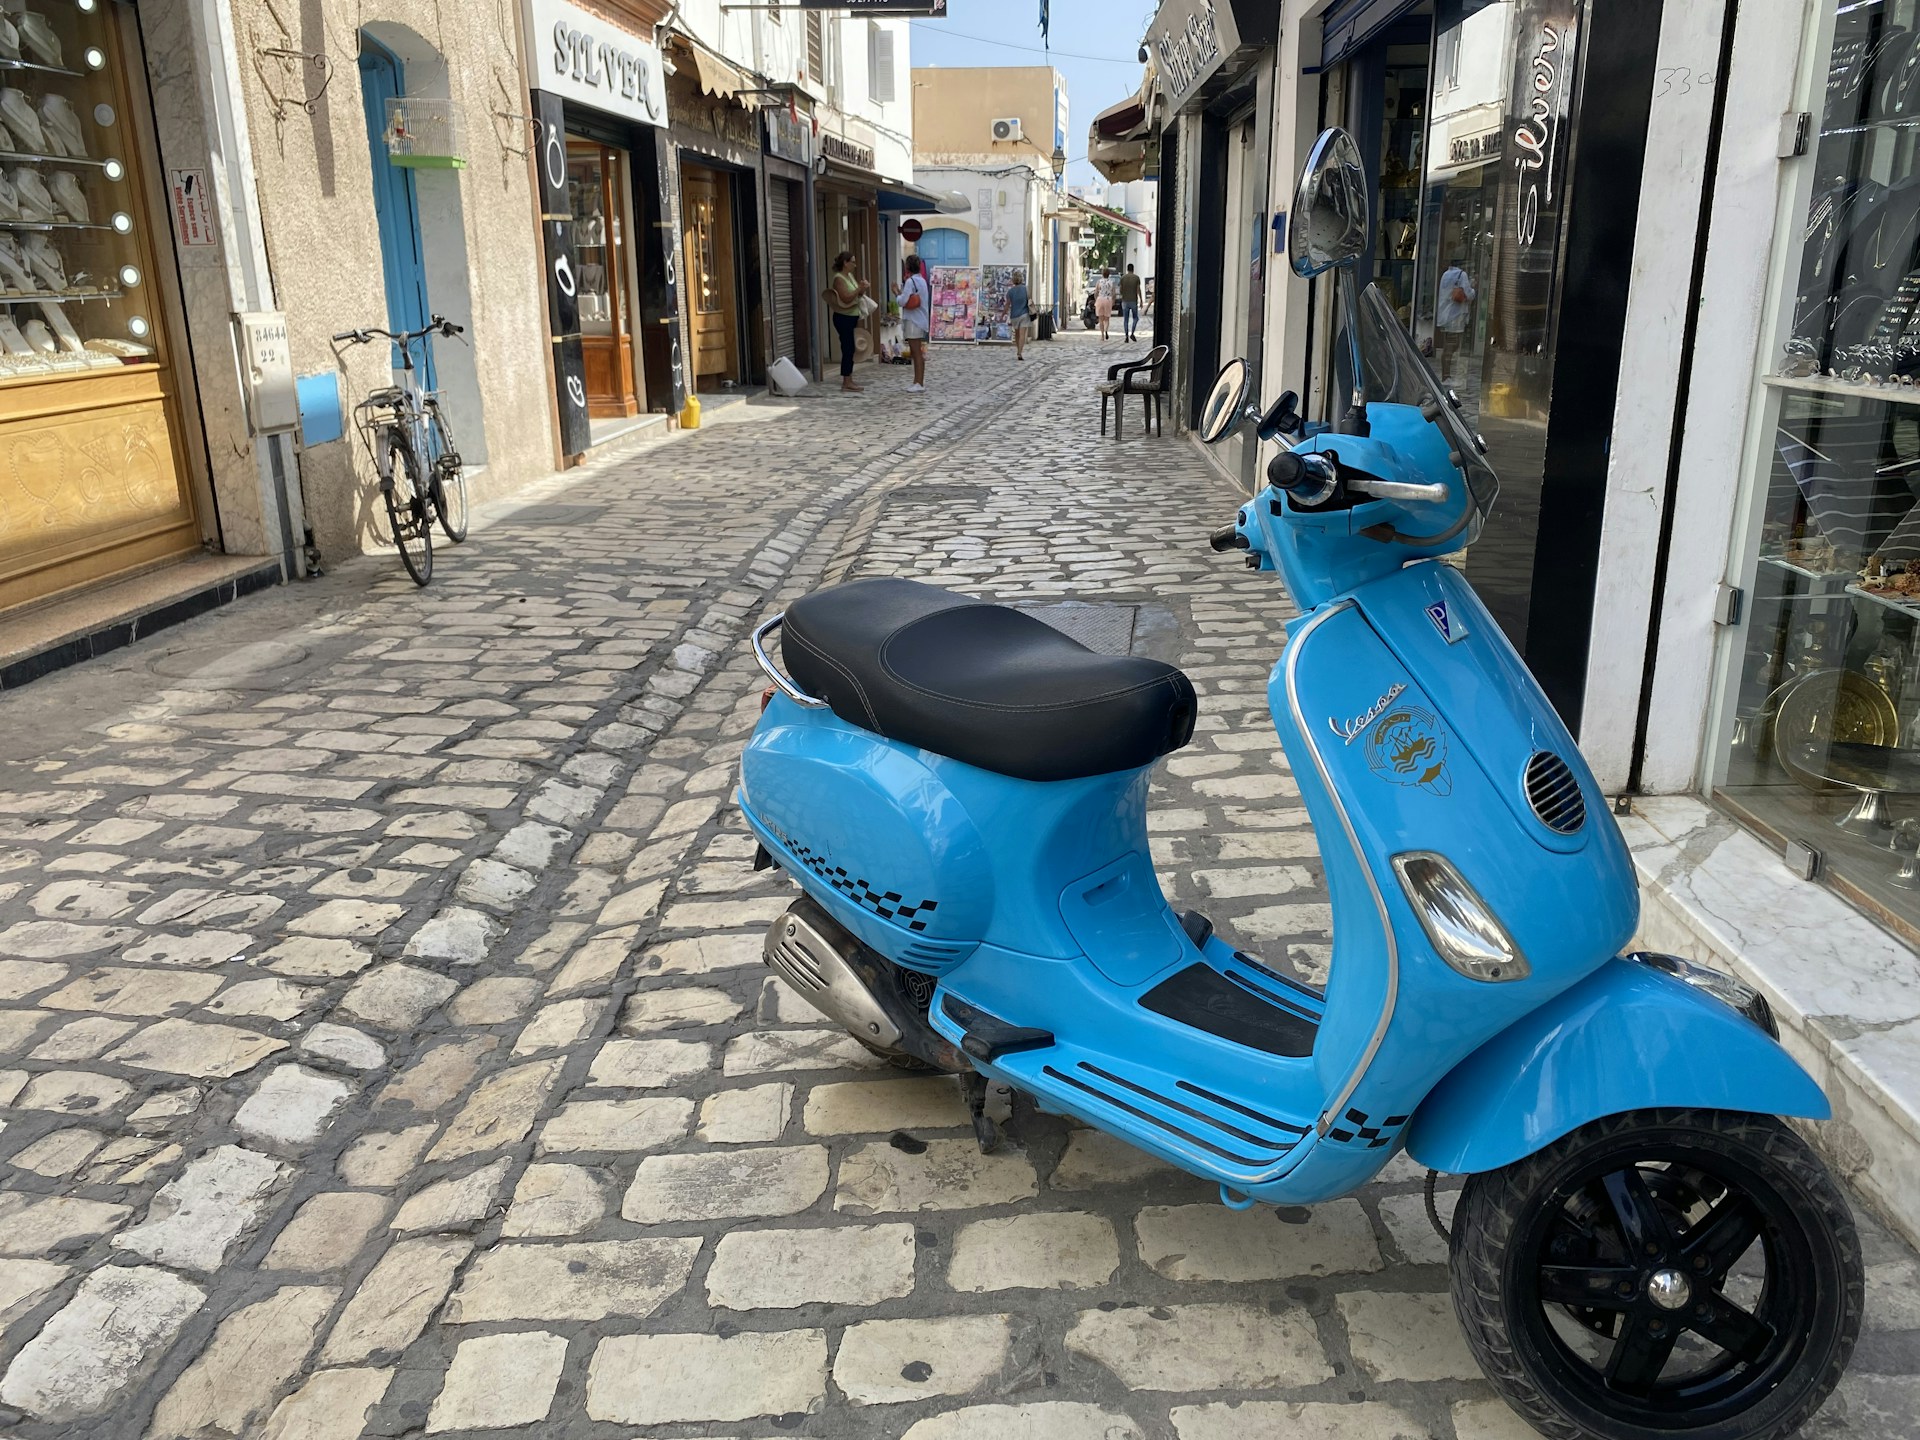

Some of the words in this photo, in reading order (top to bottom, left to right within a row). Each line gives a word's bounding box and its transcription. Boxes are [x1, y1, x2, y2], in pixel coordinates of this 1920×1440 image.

[554, 20, 660, 121] SILVER
[1159, 28, 1199, 99] Silver
[1515, 26, 1559, 245] Silver
[187, 197, 196, 221] Espace
[191, 222, 199, 239] sous
[255, 326, 287, 343] 84644
[260, 349, 276, 363] 22
[1328, 683, 1408, 746] Vespa
